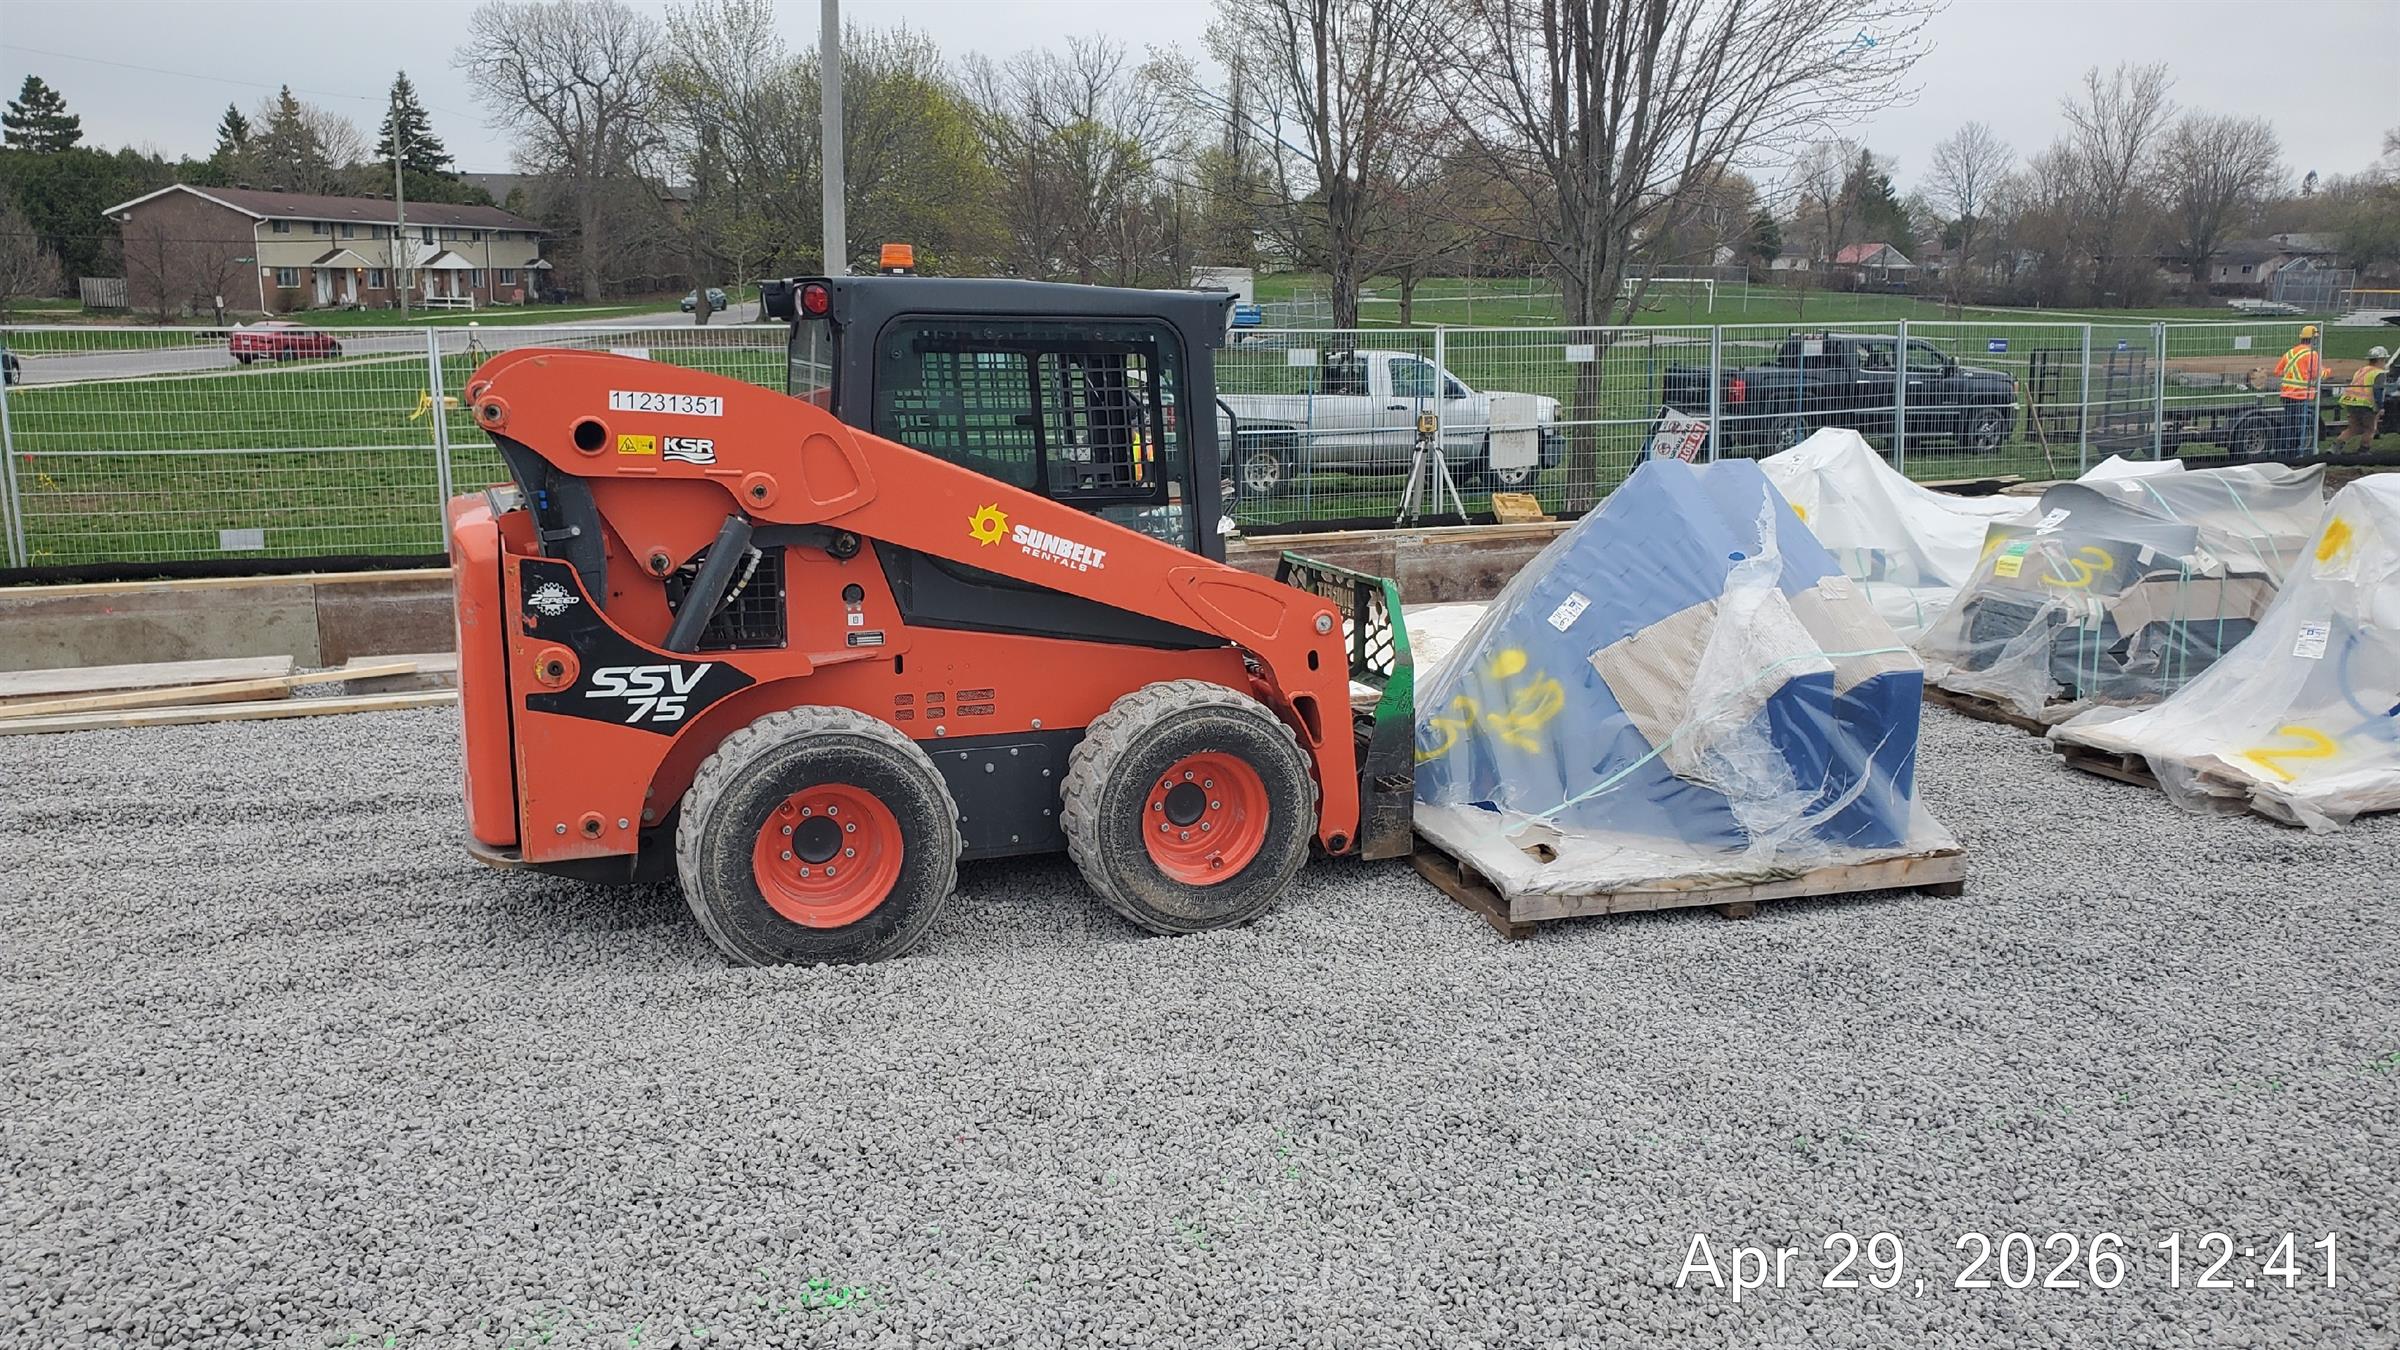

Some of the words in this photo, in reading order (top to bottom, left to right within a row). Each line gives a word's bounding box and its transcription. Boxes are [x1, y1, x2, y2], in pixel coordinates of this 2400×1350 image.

[612, 391, 718, 415] 11231351
[663, 436, 714, 455] KSR
[1012, 524, 1106, 568] SUNBELT
[1022, 545, 1088, 573] RENTALS
[585, 663, 713, 698] SSV
[625, 695, 689, 723] 75
